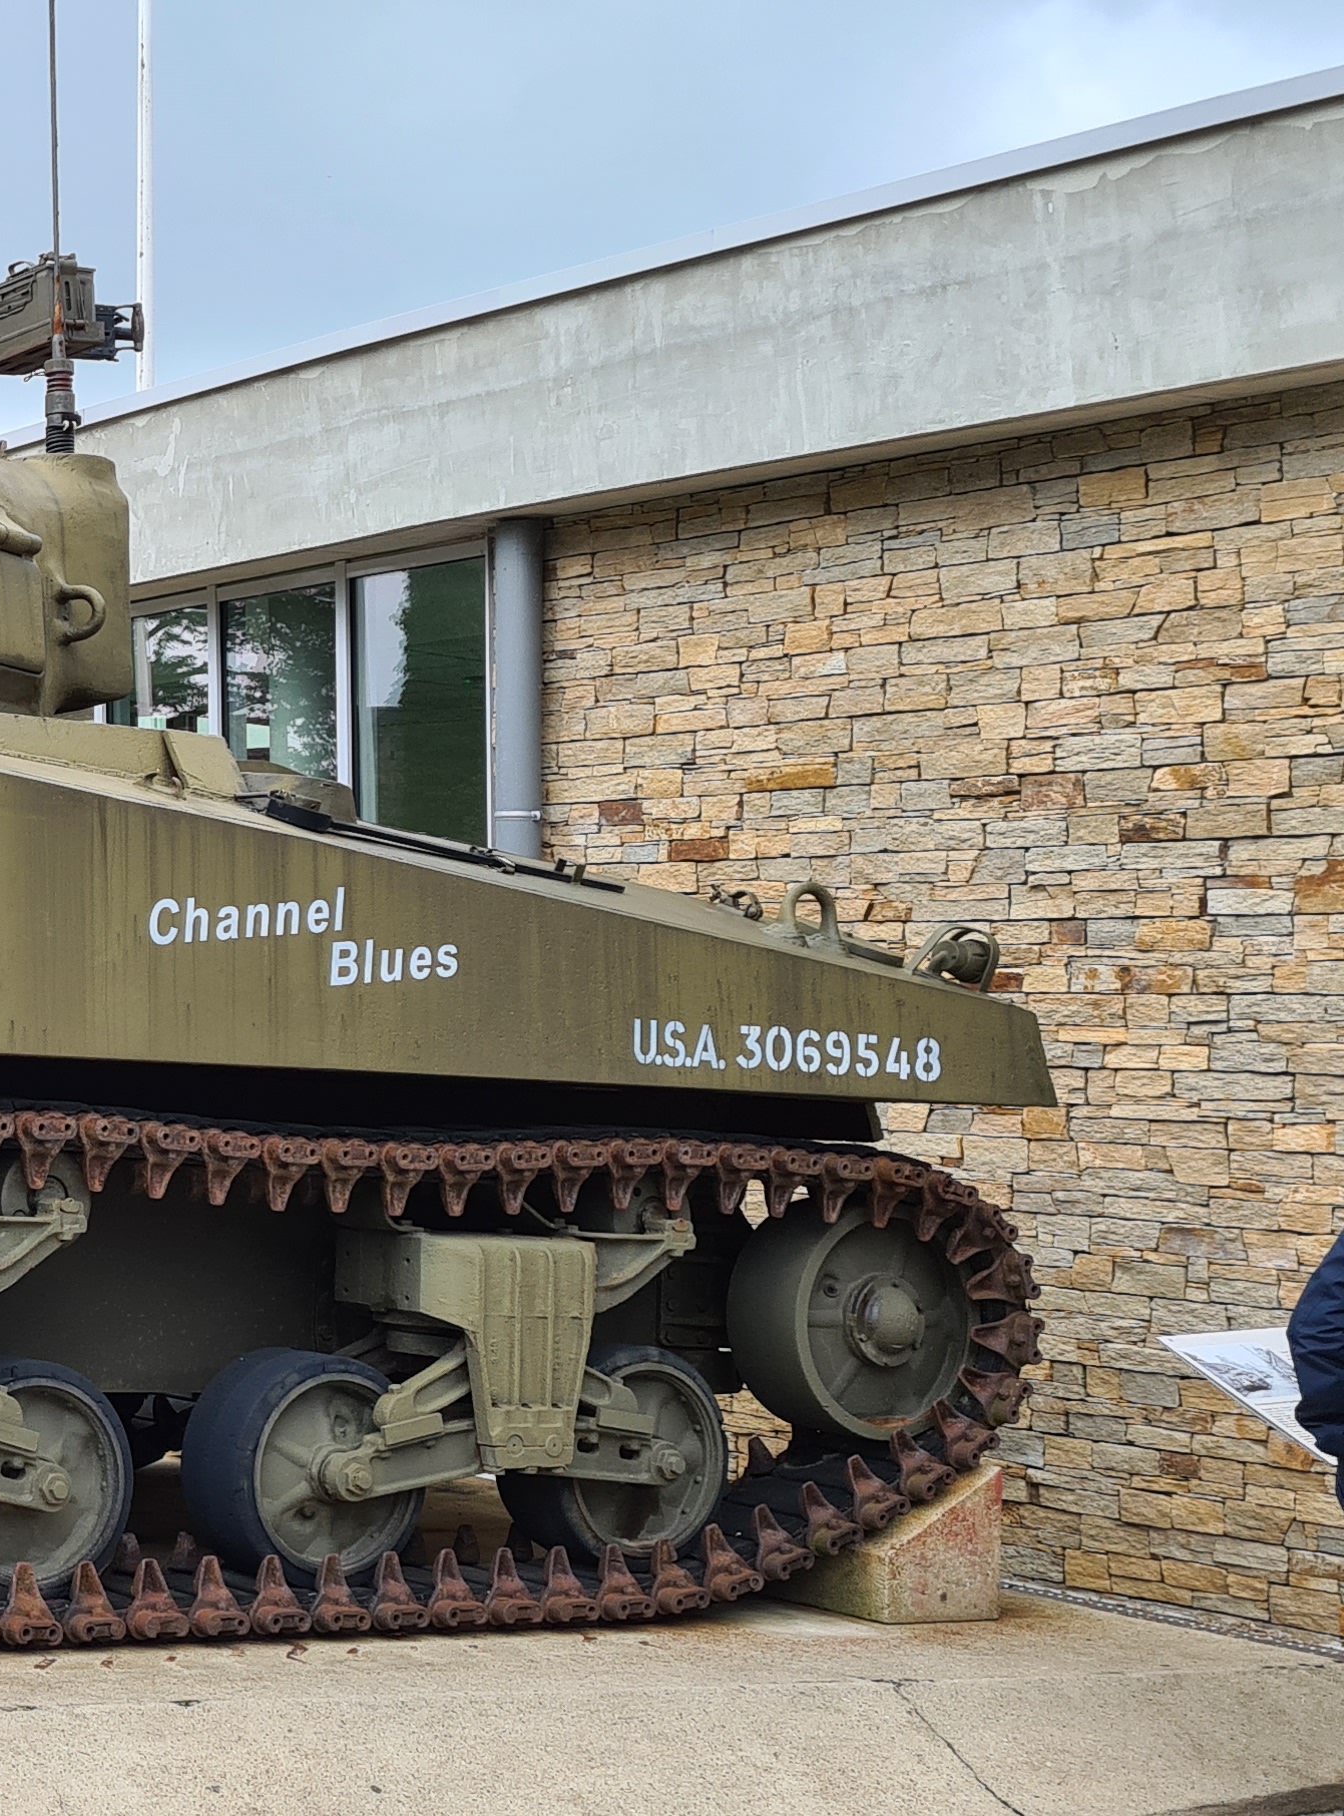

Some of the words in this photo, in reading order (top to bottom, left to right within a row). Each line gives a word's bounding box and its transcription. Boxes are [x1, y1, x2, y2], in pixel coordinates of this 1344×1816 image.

[148, 886, 345, 947] Channel
[329, 938, 459, 988] Blues
[633, 1017, 727, 1069] U.S.A.
[735, 1024, 942, 1083] 3069548
